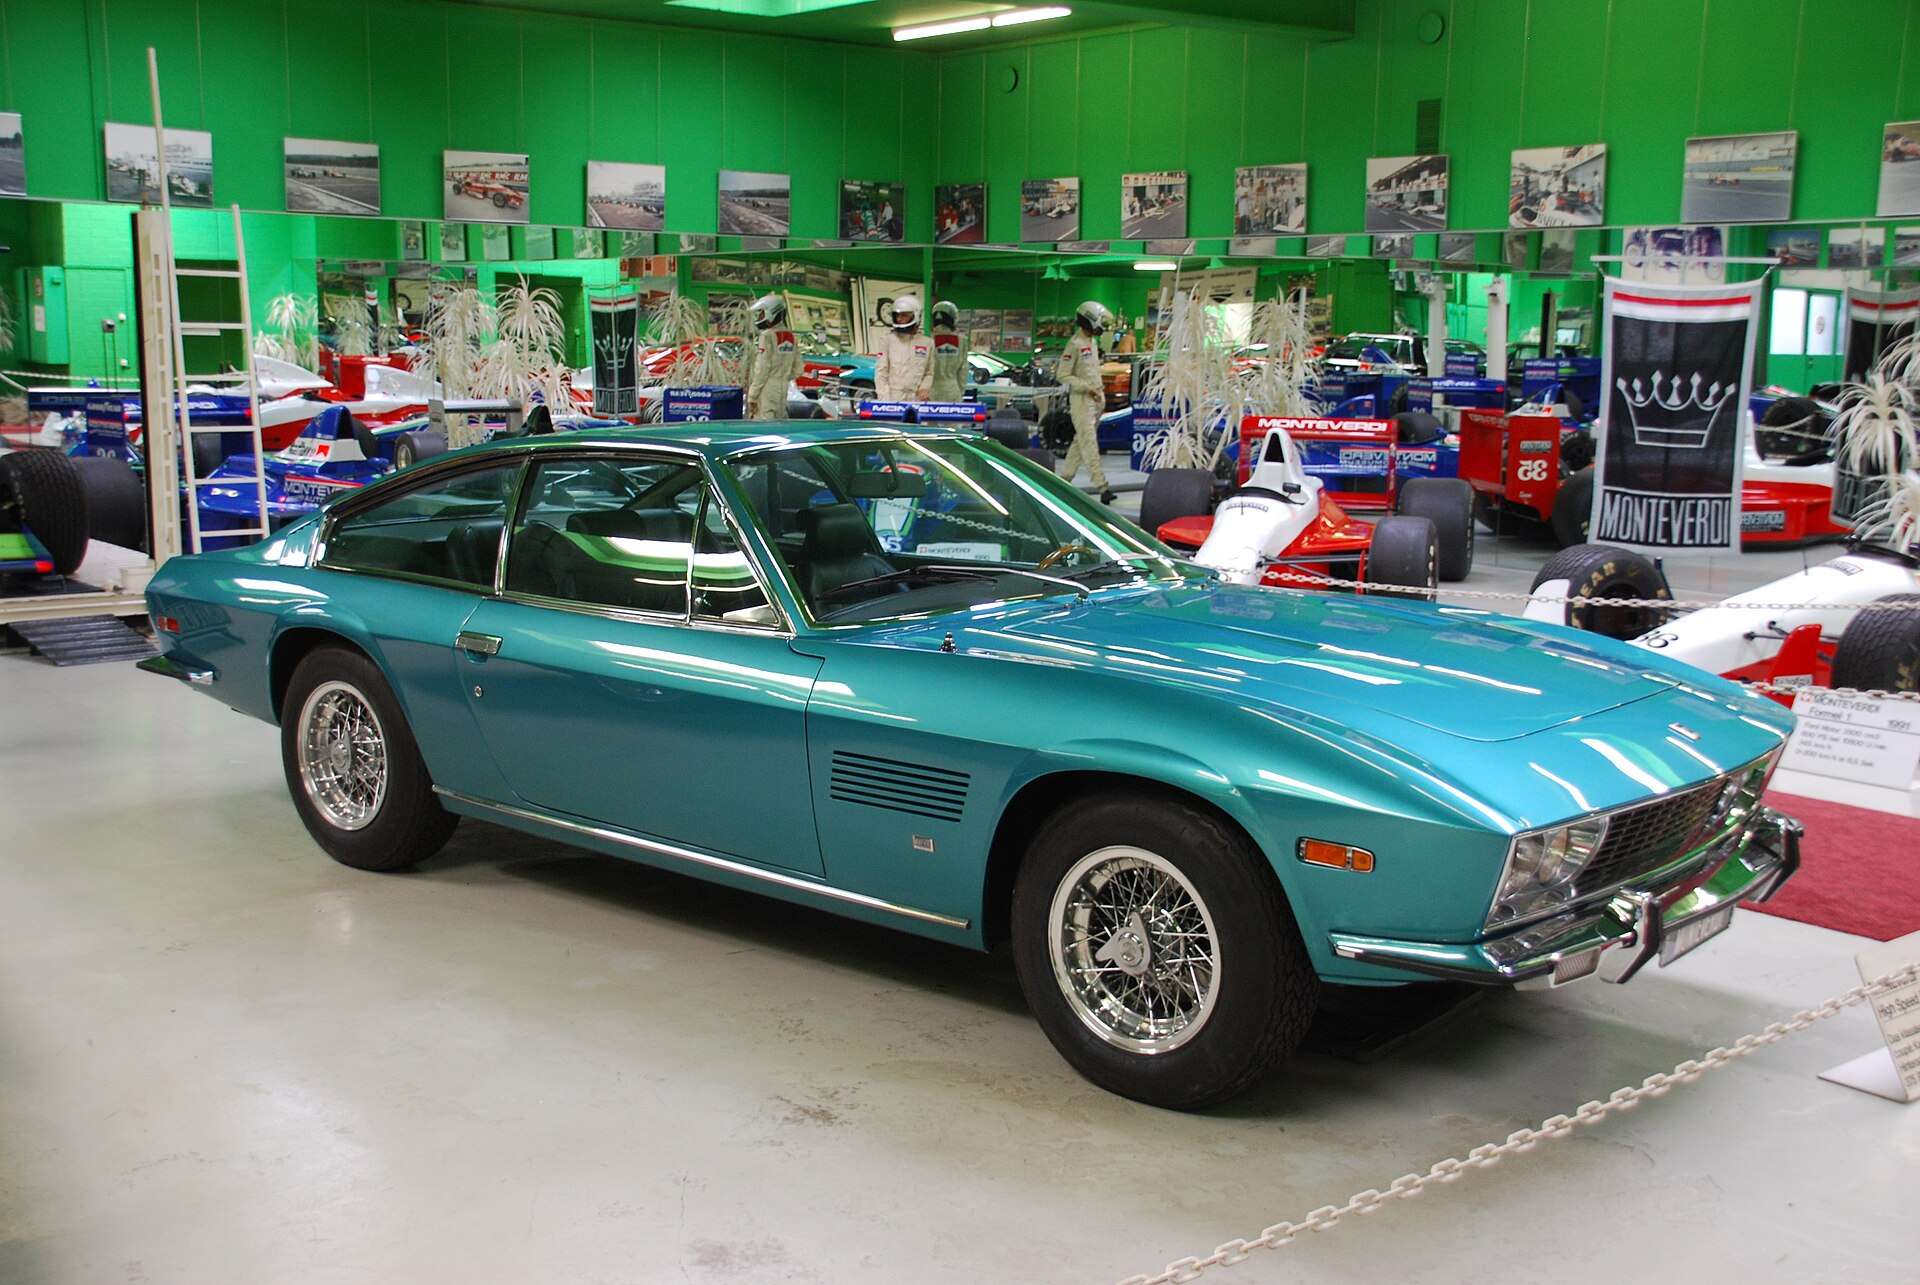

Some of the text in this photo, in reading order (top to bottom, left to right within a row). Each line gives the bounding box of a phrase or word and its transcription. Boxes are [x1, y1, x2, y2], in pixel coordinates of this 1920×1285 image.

[1257, 417, 1388, 432] MONTEVERDI
[284, 481, 340, 498] MONTEV
[1600, 492, 1730, 545] MONTEVERDI
[1814, 694, 1881, 713] MONTEVERDI
